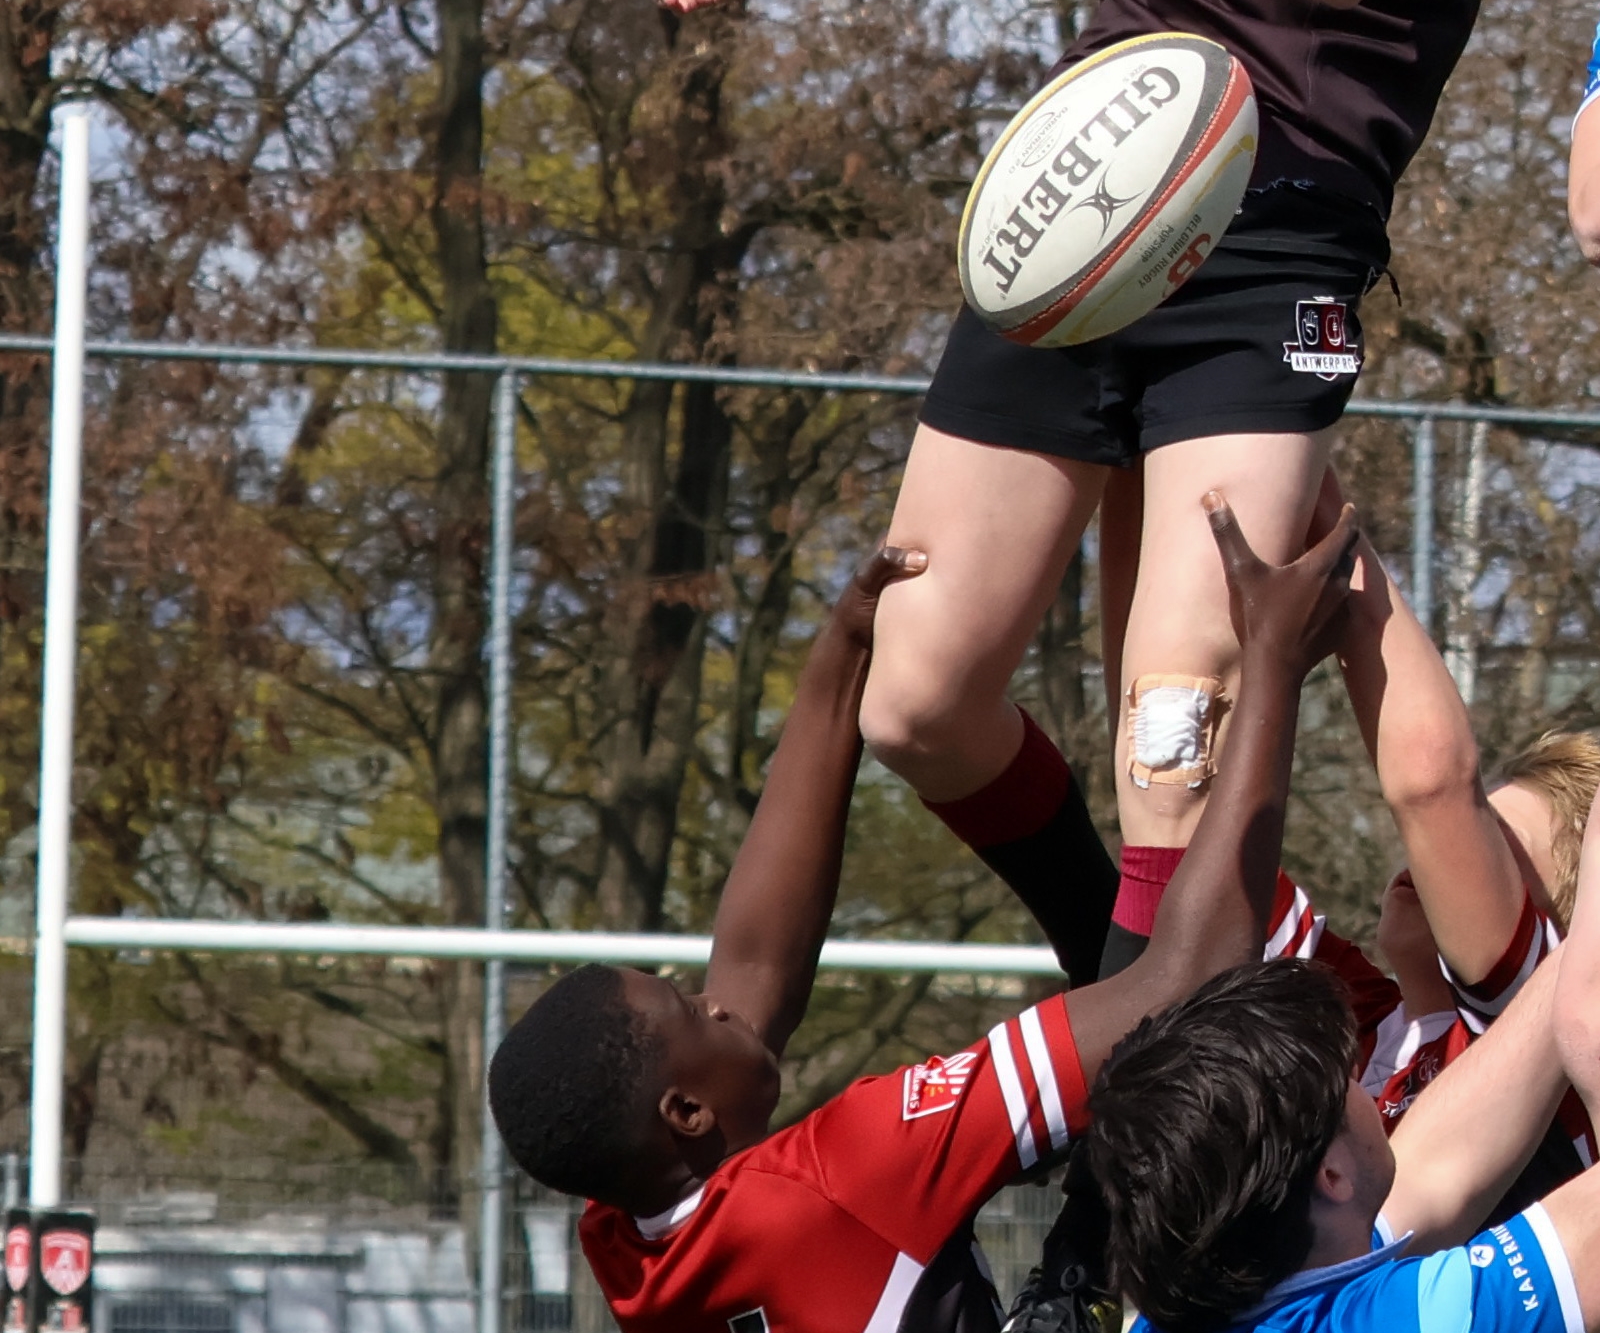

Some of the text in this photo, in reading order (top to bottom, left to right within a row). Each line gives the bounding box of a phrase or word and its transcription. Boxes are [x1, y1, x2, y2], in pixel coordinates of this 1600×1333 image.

[982, 66, 1182, 294] GILBERT
[1166, 214, 1202, 259] BELGIUM
[1138, 257, 1169, 289] RUGBY
[1294, 355, 1341, 370] ANTWERP
